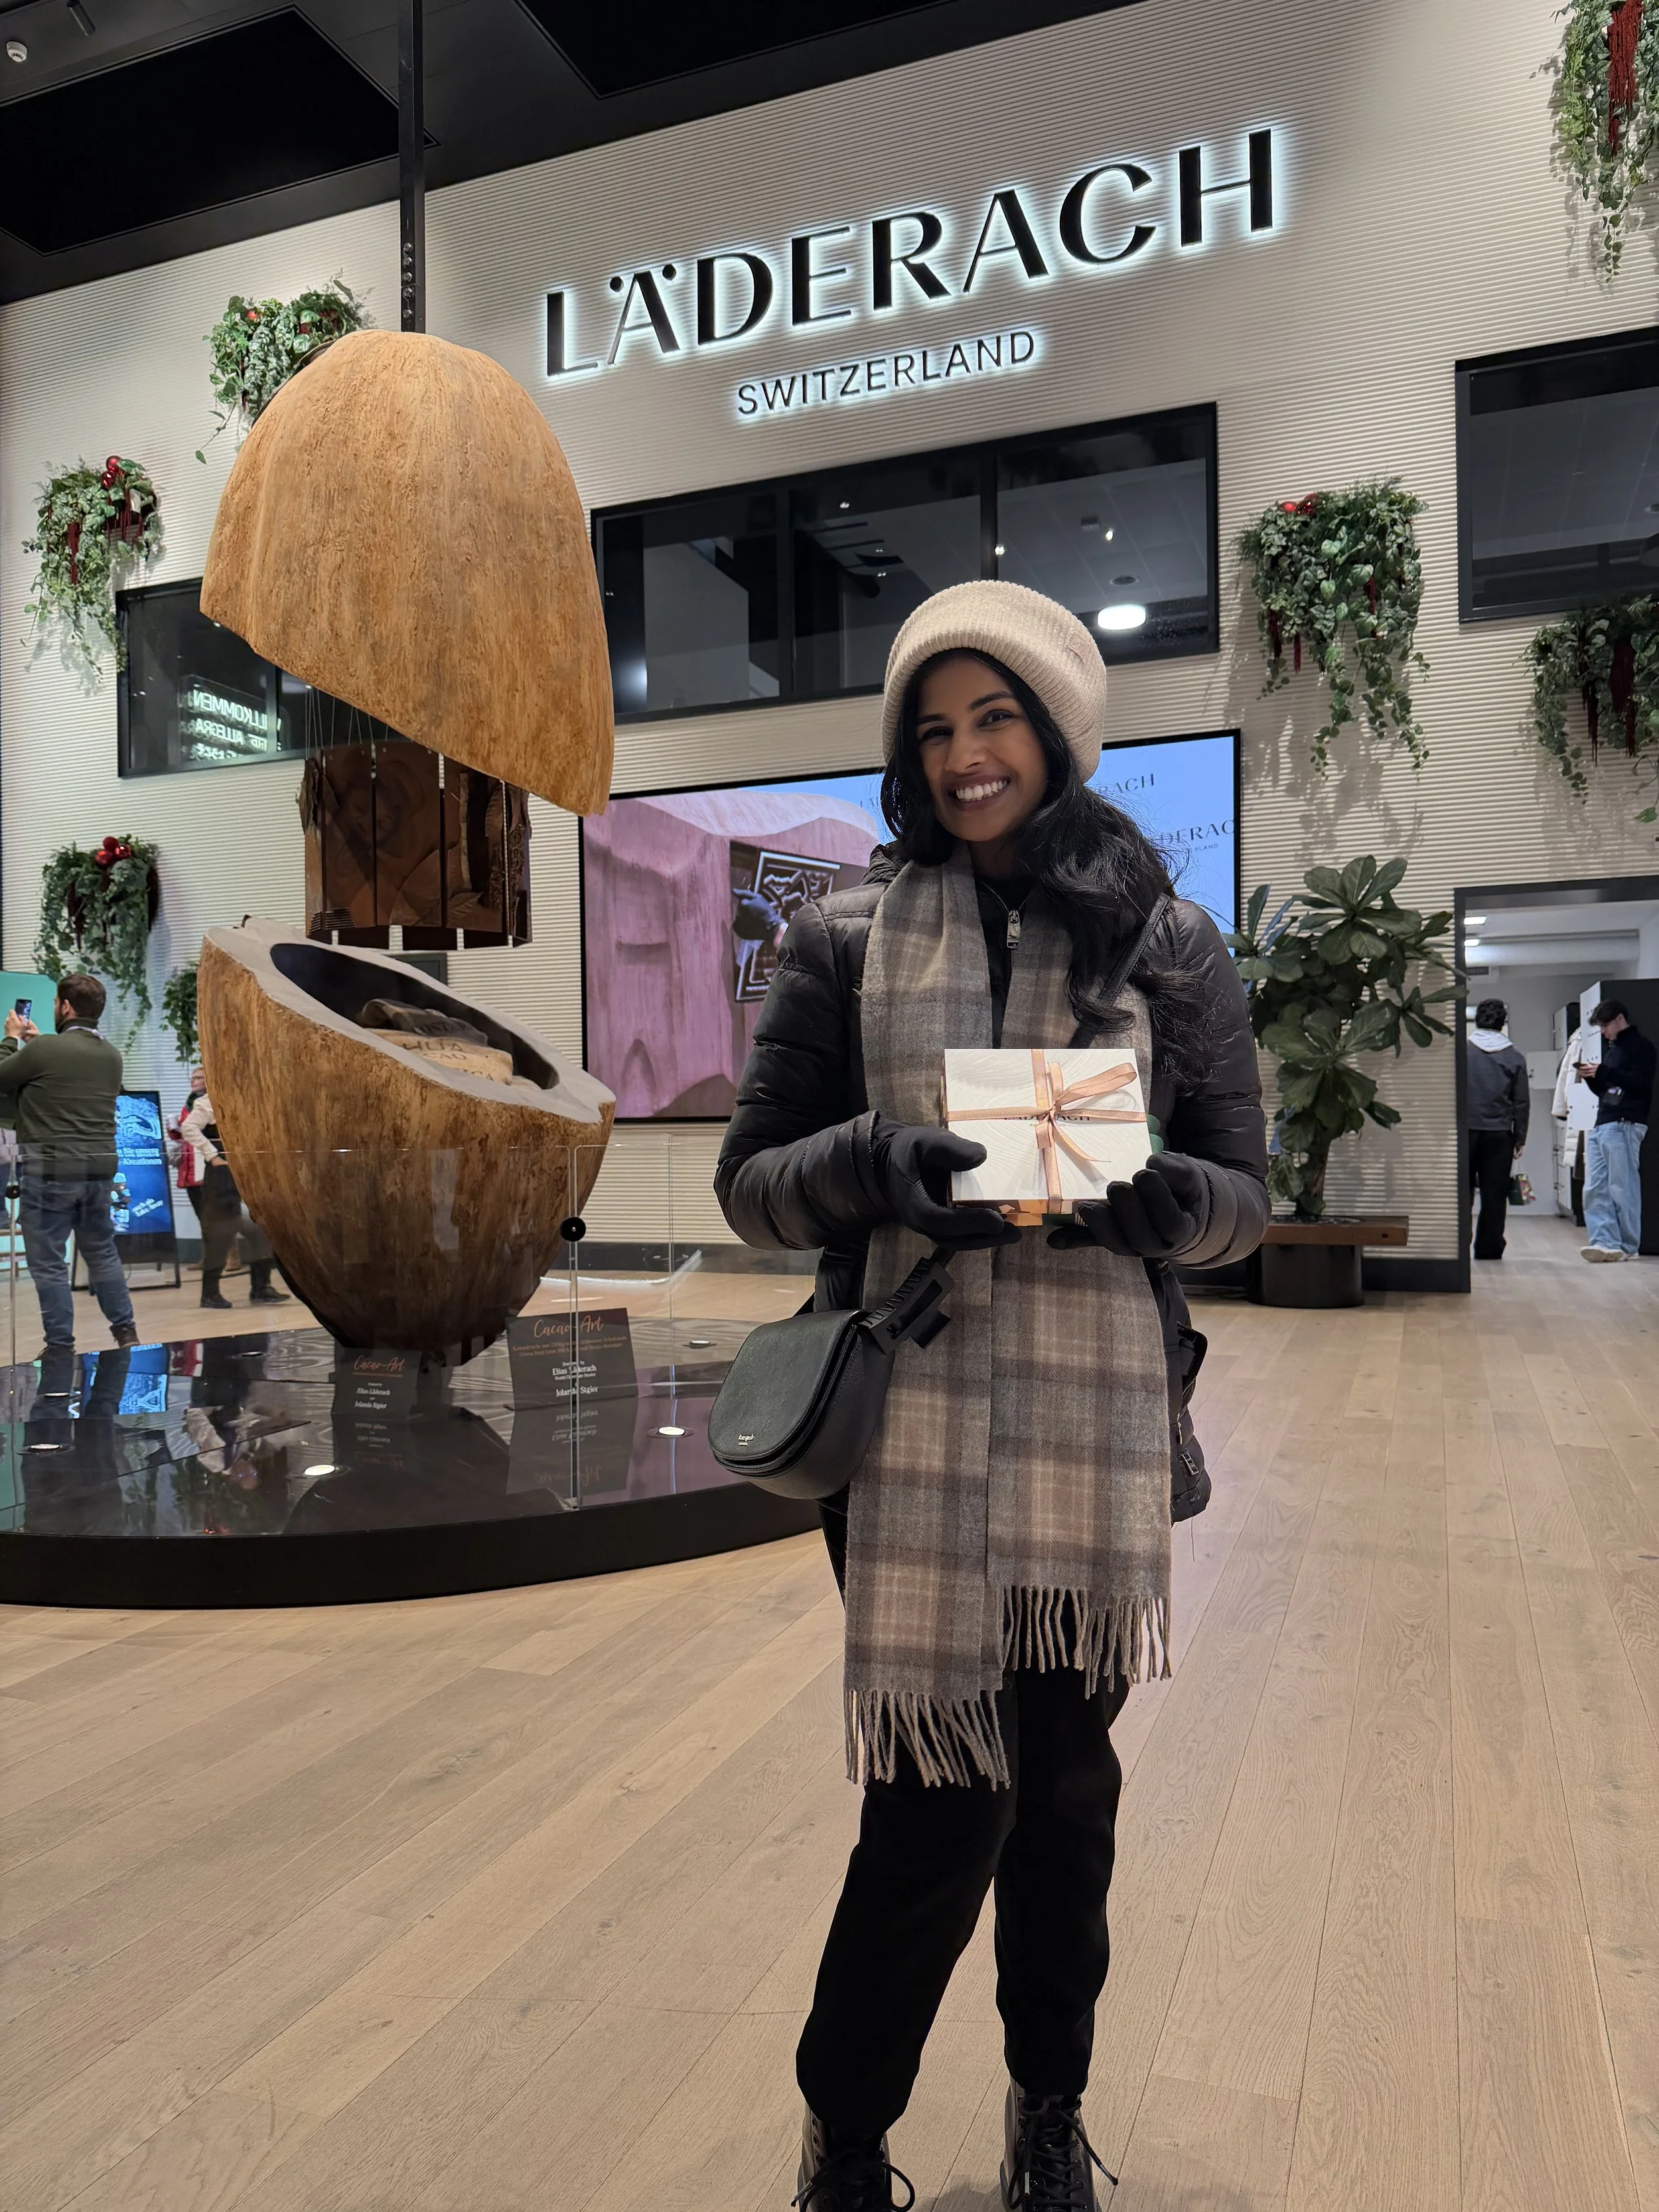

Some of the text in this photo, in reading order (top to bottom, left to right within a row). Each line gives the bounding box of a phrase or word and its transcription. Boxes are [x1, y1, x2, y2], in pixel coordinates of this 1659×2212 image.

[545, 127, 1273, 378] LÄDERACH
[737, 331, 1036, 417] SWITZERLAND
[534, 1315, 604, 1338] Cacao Art
